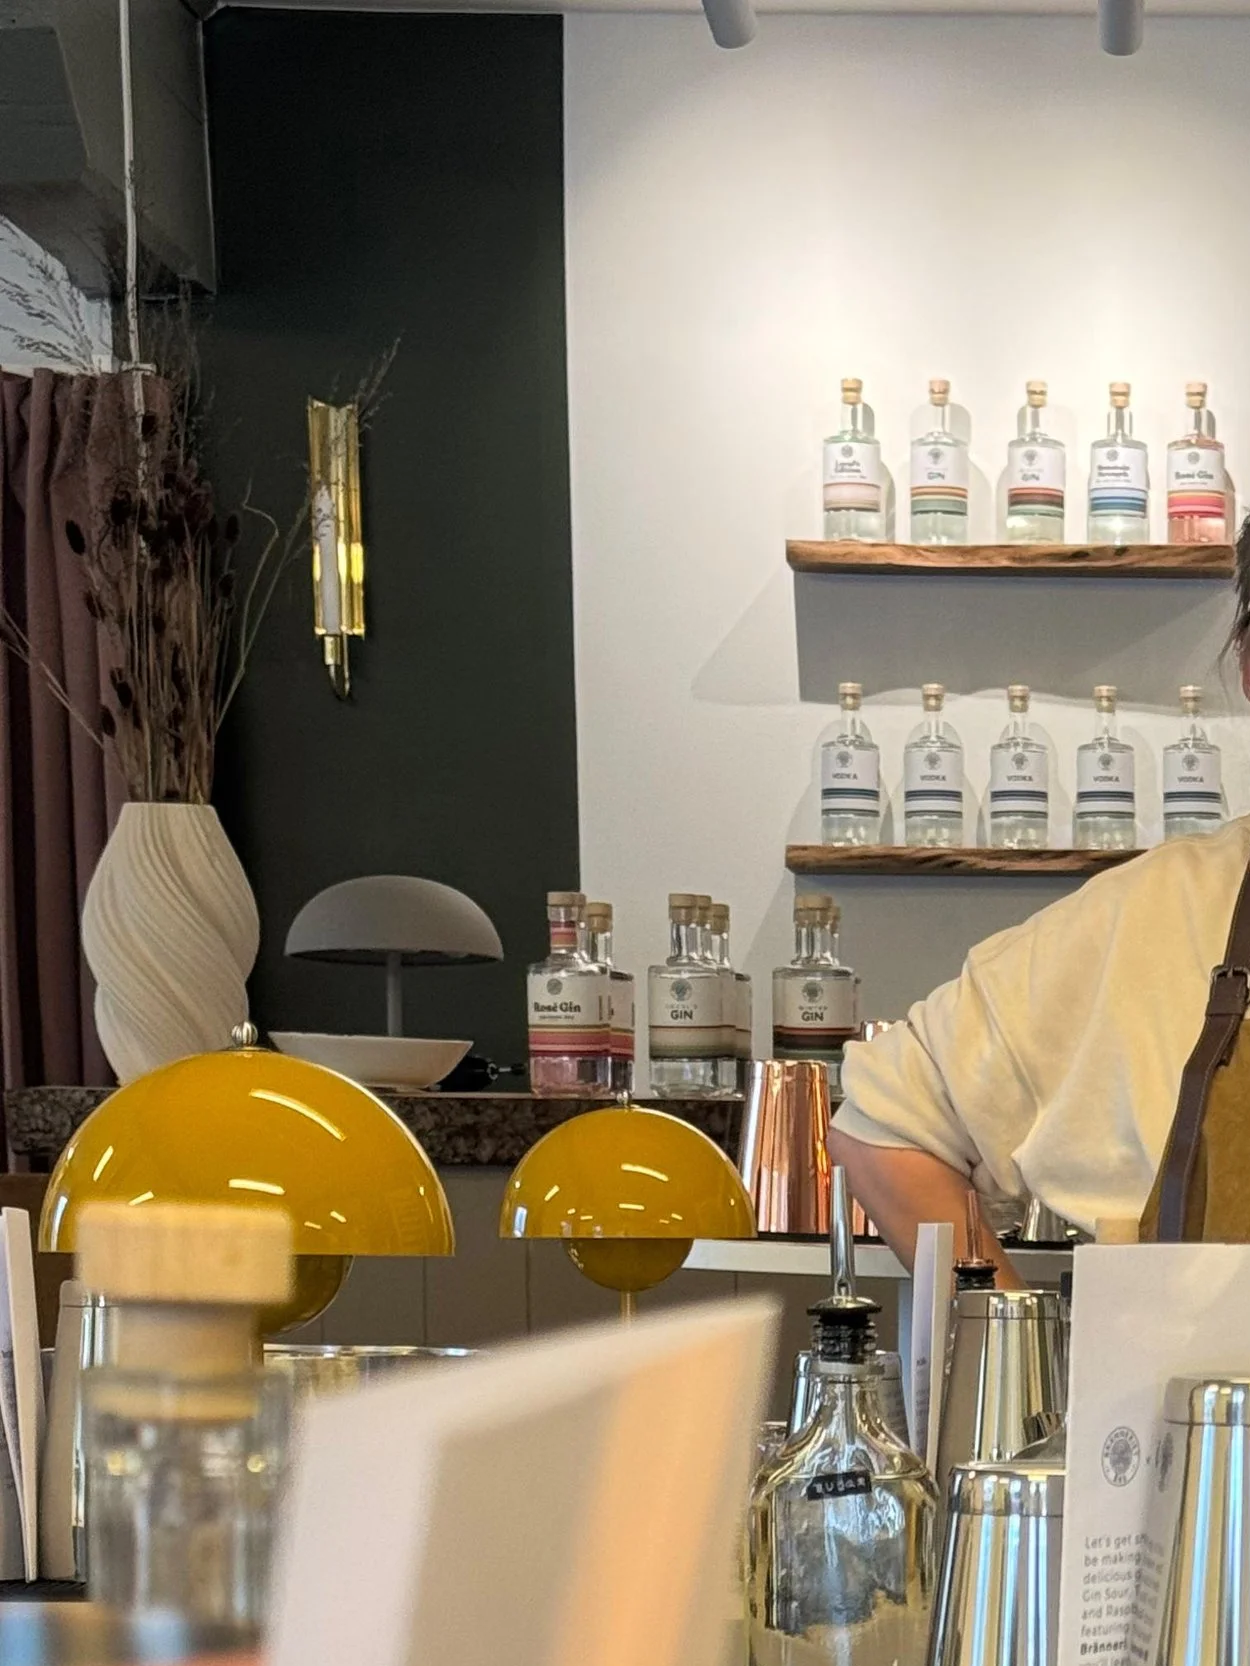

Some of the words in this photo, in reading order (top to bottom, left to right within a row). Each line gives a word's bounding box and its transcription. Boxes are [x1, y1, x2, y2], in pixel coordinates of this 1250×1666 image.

[832, 772, 858, 780] VODKA
[920, 774, 946, 782] VODKA
[1006, 774, 1033, 782] VODKA
[1093, 775, 1120, 783] VODKA
[534, 1001, 558, 1012] Rosé
[560, 1001, 581, 1012] Gin
[670, 1009, 693, 1020] GIN
[801, 1011, 824, 1021] GIN
[1114, 1534, 1131, 1549] get
[1084, 1554, 1098, 1567] be
[1082, 1589, 1101, 1602] Gin
[1082, 1606, 1103, 1621] and
